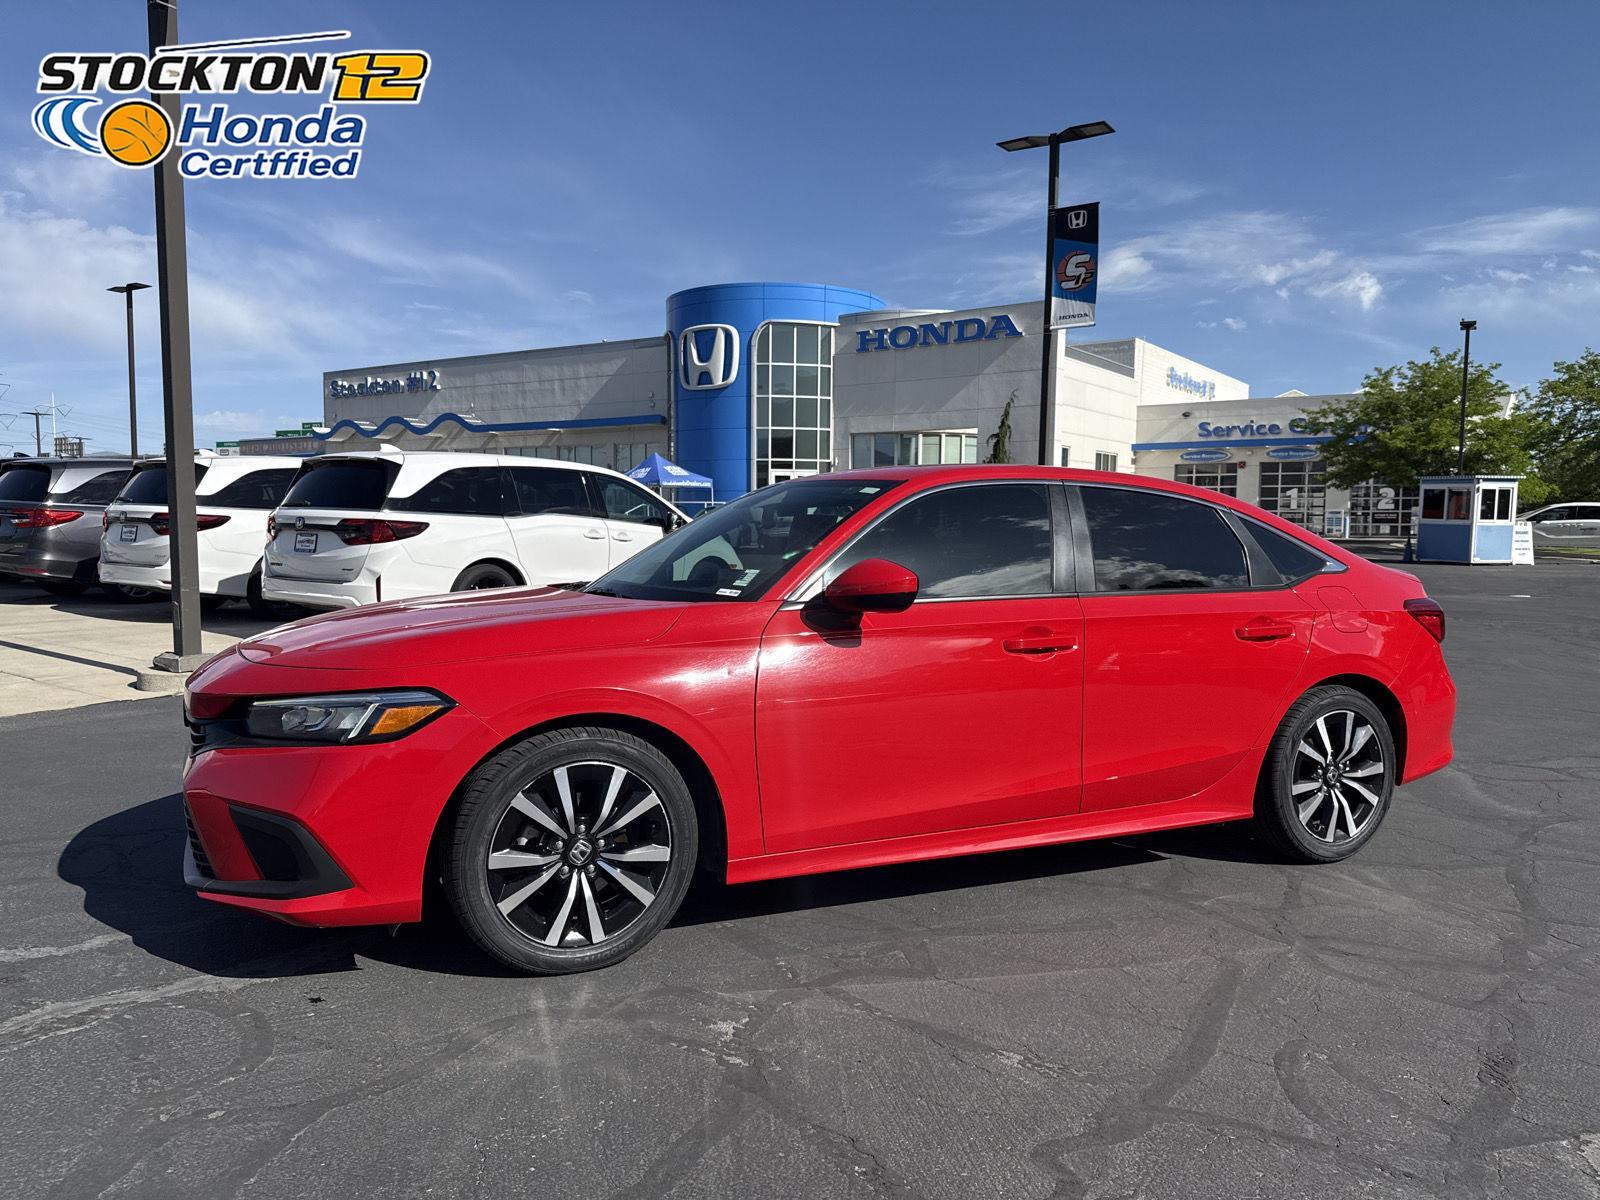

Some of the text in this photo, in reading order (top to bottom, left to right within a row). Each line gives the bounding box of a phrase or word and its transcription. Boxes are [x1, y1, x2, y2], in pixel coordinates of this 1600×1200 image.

[1058, 313, 1089, 321] HONDA
[856, 313, 1024, 353] HONDA
[330, 369, 441, 398] Stockton #12
[1197, 419, 1281, 438] Service
[1285, 487, 1299, 510] 1
[1377, 487, 1396, 510] 2
